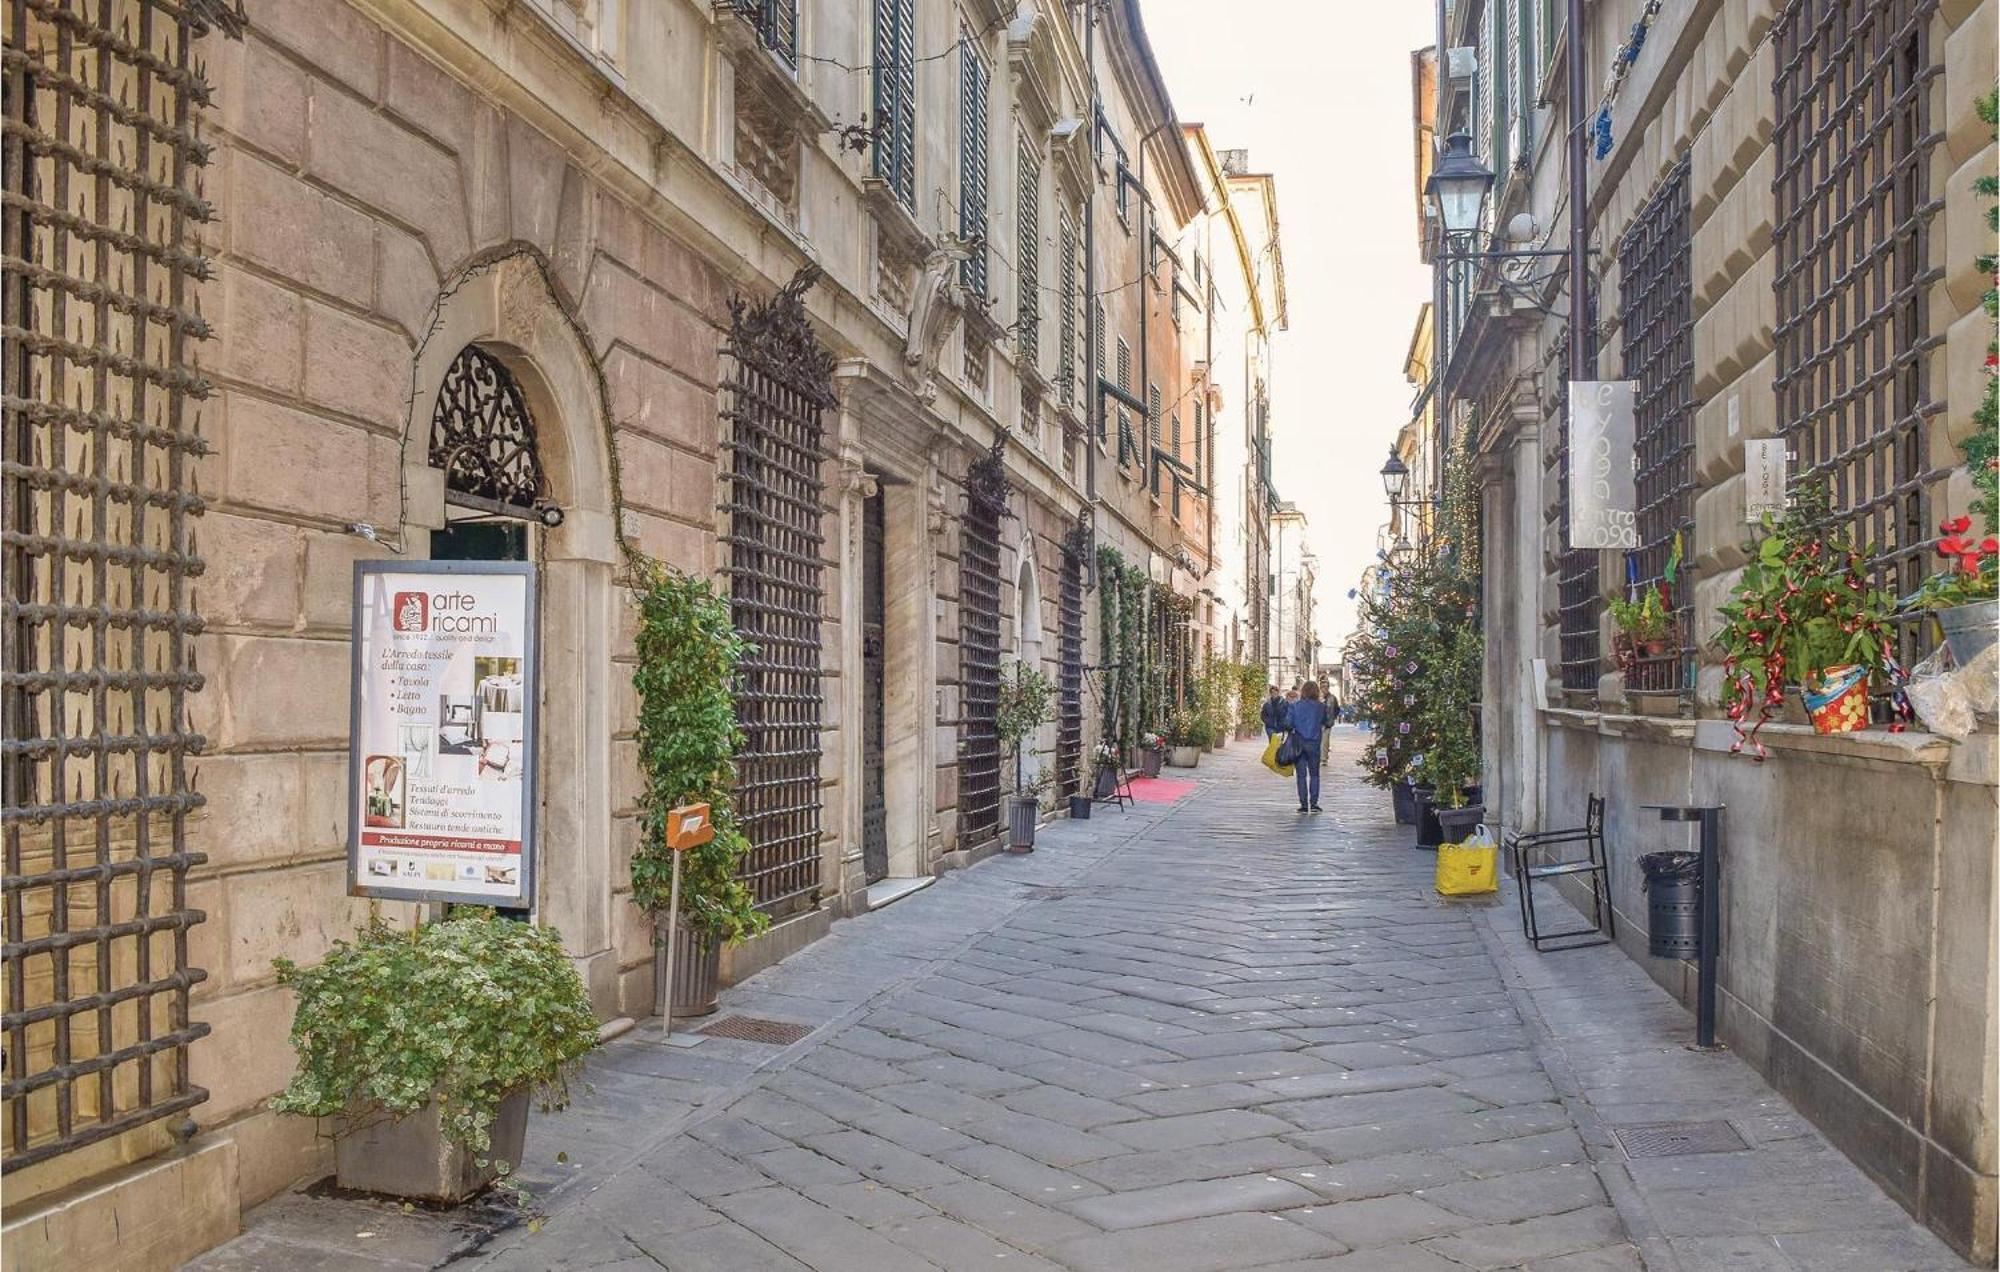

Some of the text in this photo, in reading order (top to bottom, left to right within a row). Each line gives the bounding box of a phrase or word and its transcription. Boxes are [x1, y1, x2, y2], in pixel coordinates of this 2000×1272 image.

[433, 590, 475, 611] arte
[433, 612, 497, 633] ricami
[424, 650, 453, 660] tessile
[397, 677, 429, 687] Tavola
[396, 691, 421, 700] Letto
[396, 705, 427, 716] Bagno
[410, 783, 439, 794] Tessuti
[440, 808, 450, 818] di
[379, 835, 420, 846] Produzione
[421, 838, 449, 849] propria
[450, 839, 475, 849] ricami
[482, 843, 505, 851] mano
